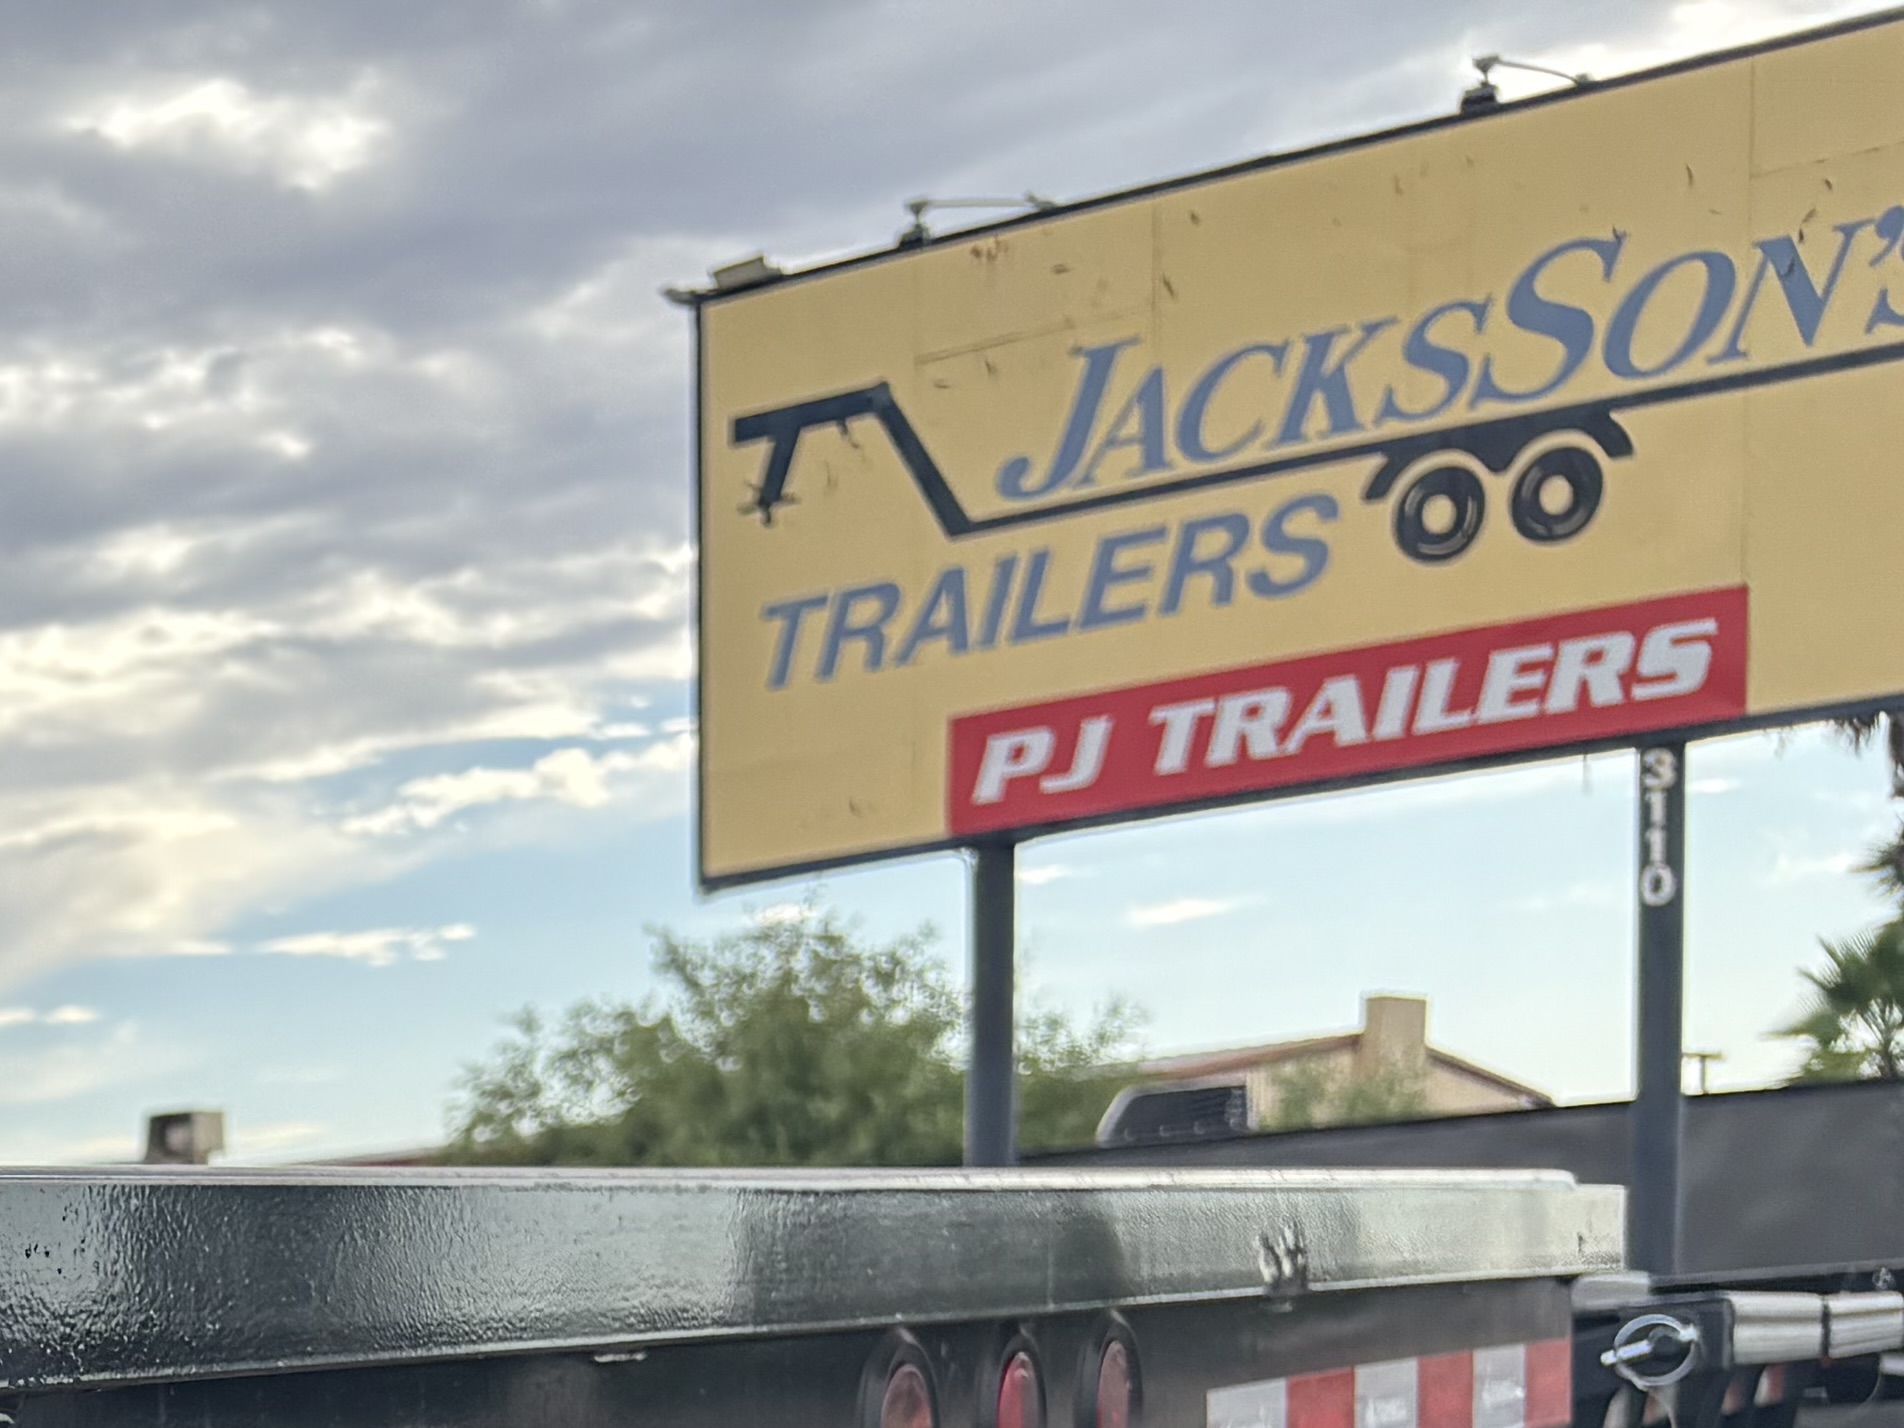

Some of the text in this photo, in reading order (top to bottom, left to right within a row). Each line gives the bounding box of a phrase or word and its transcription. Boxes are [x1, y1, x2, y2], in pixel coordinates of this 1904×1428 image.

[759, 490, 1340, 692] TRAILERS
[971, 616, 1718, 805] PJ TRAILERS
[1641, 748, 1678, 907] 3110
